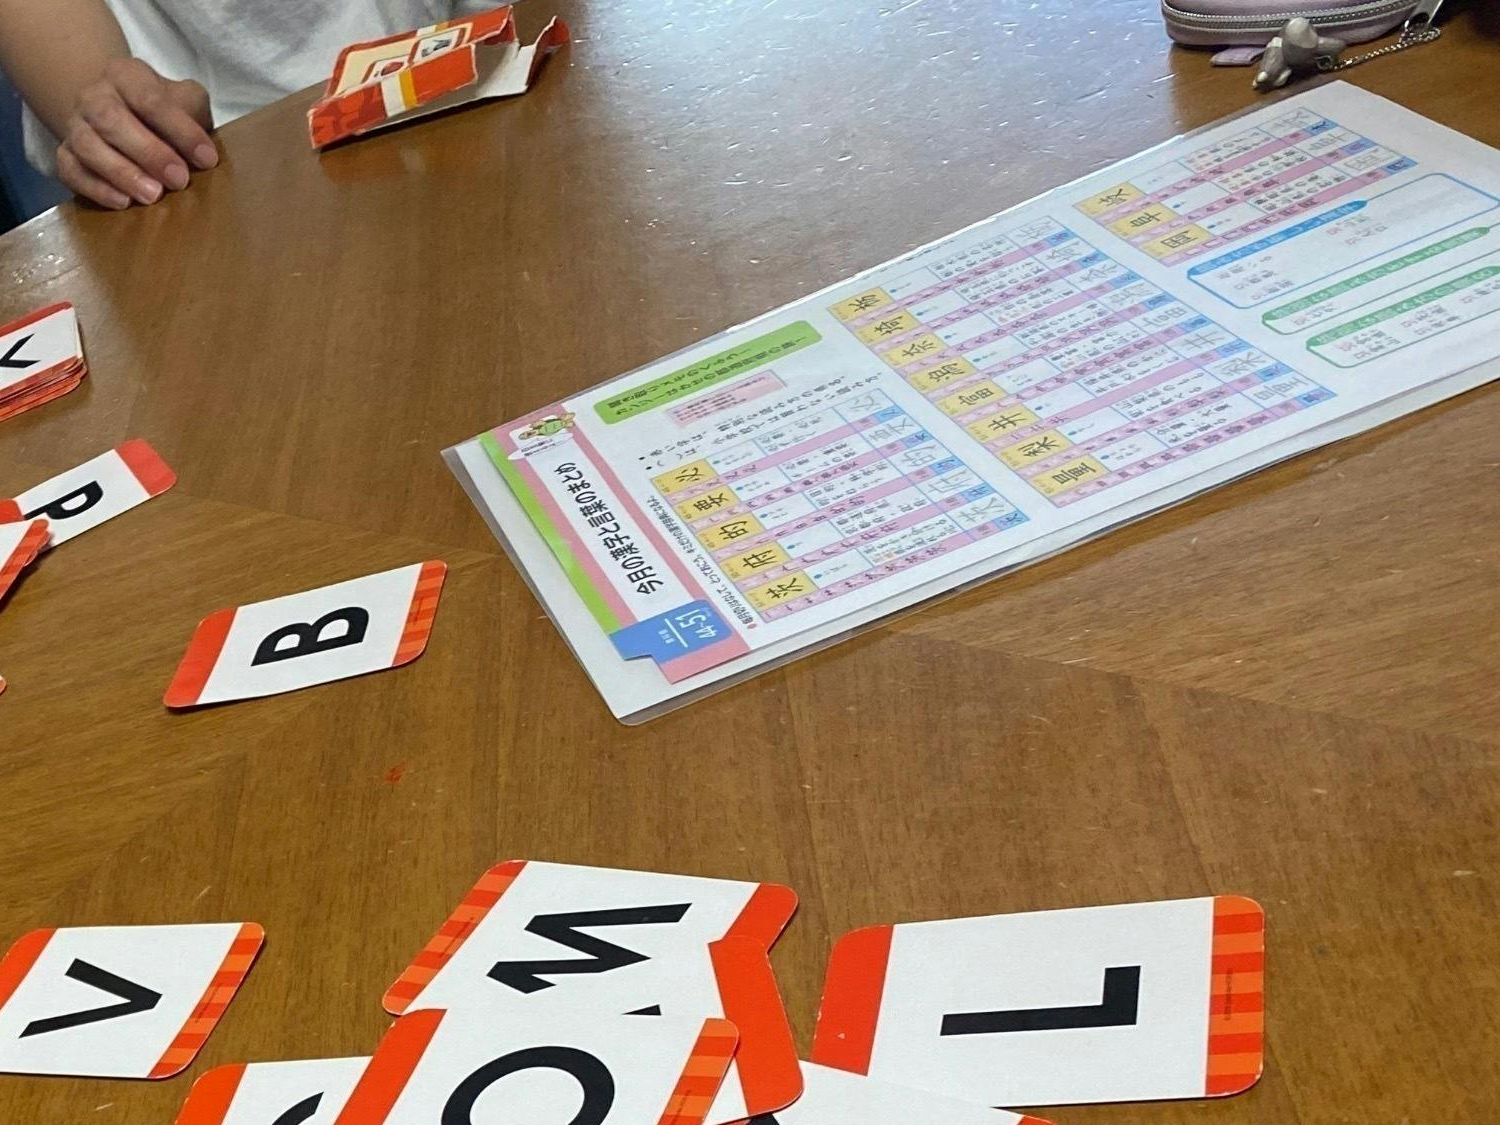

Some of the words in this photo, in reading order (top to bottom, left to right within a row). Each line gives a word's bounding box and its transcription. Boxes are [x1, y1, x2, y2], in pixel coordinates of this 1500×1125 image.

[955, 384, 997, 408] 富
[983, 408, 1028, 433] 井
[1015, 434, 1061, 459] 梨
[672, 464, 706, 486] 必
[1048, 460, 1098, 487] 量
[24, 480, 103, 520] P
[690, 490, 730, 513] 要
[549, 459, 668, 597] 今月の漢字と言葉のまとめ
[715, 518, 754, 541] 的
[738, 547, 781, 572] 府
[251, 606, 369, 667] B
[20, 959, 162, 1038] V
[941, 966, 1141, 1036] L
